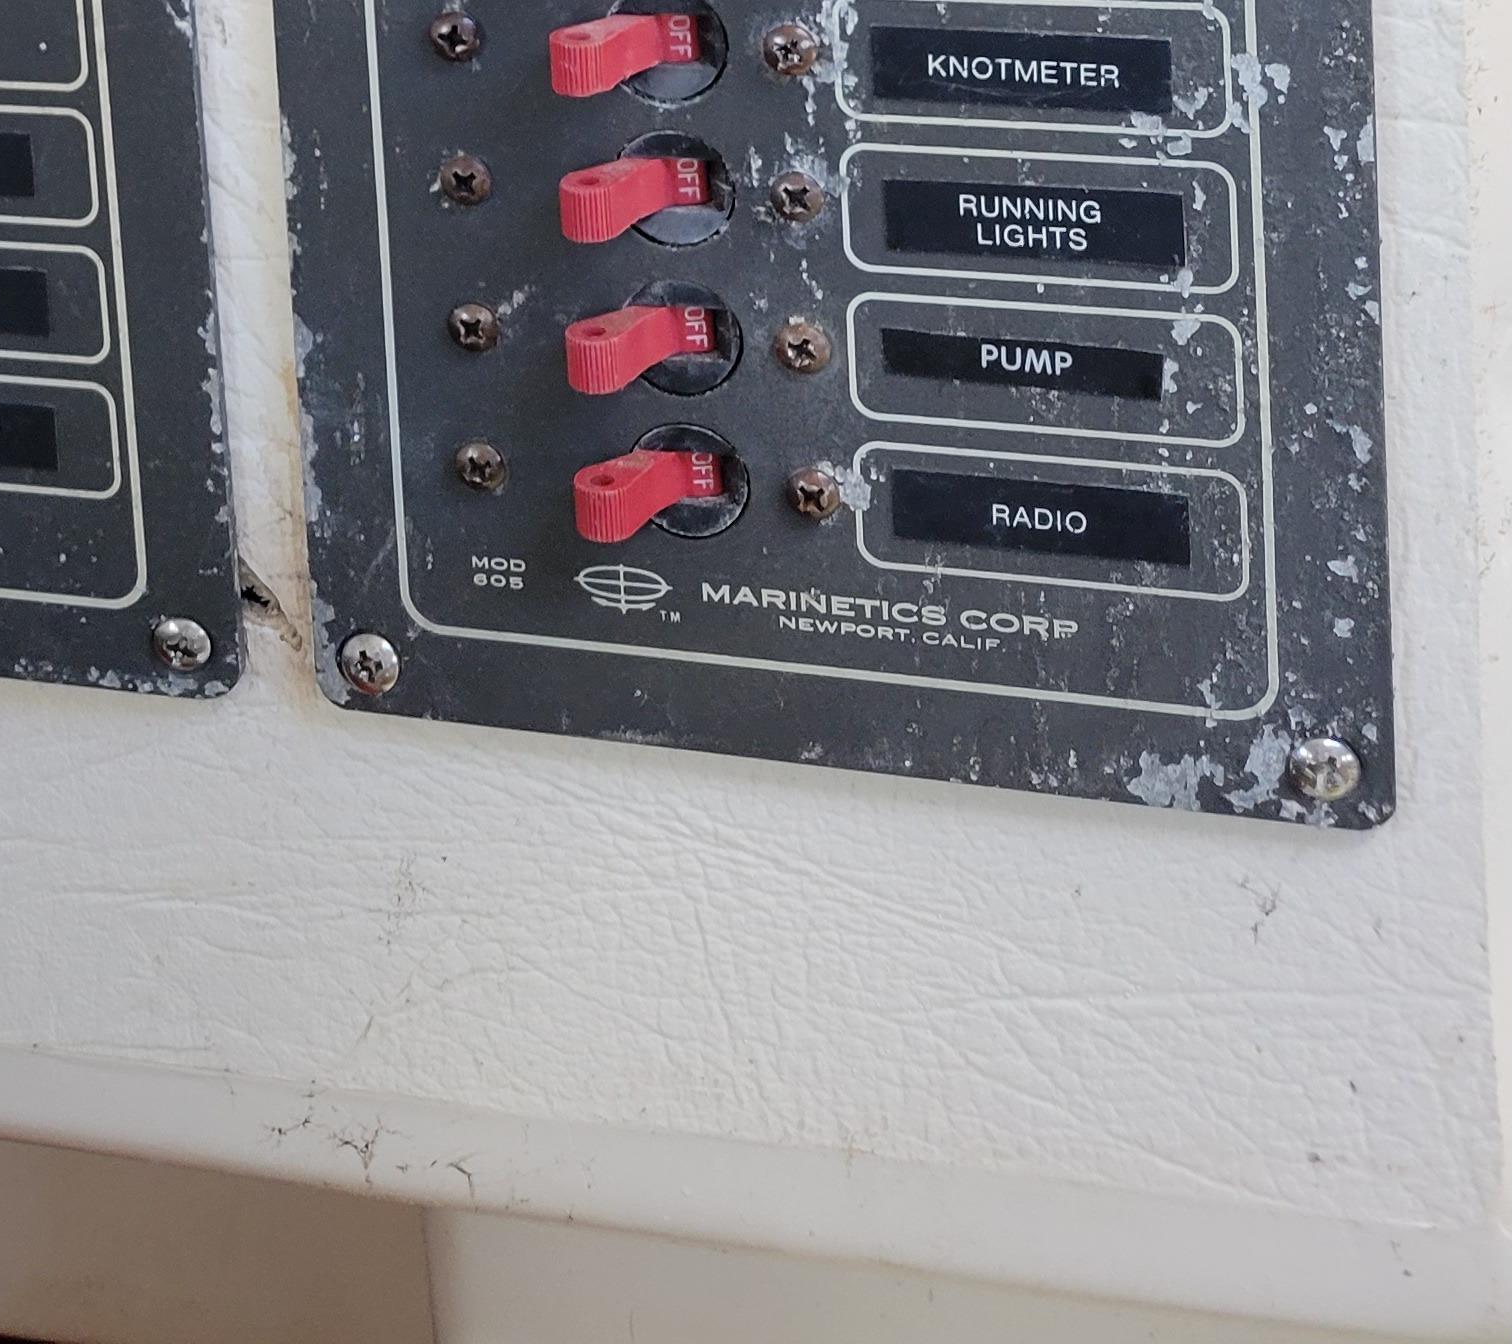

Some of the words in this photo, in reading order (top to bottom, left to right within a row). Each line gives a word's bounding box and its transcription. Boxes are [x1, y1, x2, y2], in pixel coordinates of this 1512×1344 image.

[668, 15, 693, 61] OFF
[927, 53, 1120, 89] KNOTMETER
[677, 158, 701, 202] OFF
[959, 193, 1101, 224] RUNNING
[976, 222, 1087, 251] LIGHTS
[684, 307, 708, 350] OFF
[980, 342, 1073, 377] PUMP
[691, 452, 715, 492] OFF
[991, 503, 1087, 535] RADIO
[471, 555, 526, 573] MOD
[472, 573, 524, 590] 605
[700, 581, 948, 627] MARINETICS
[959, 608, 1080, 640] CORP
